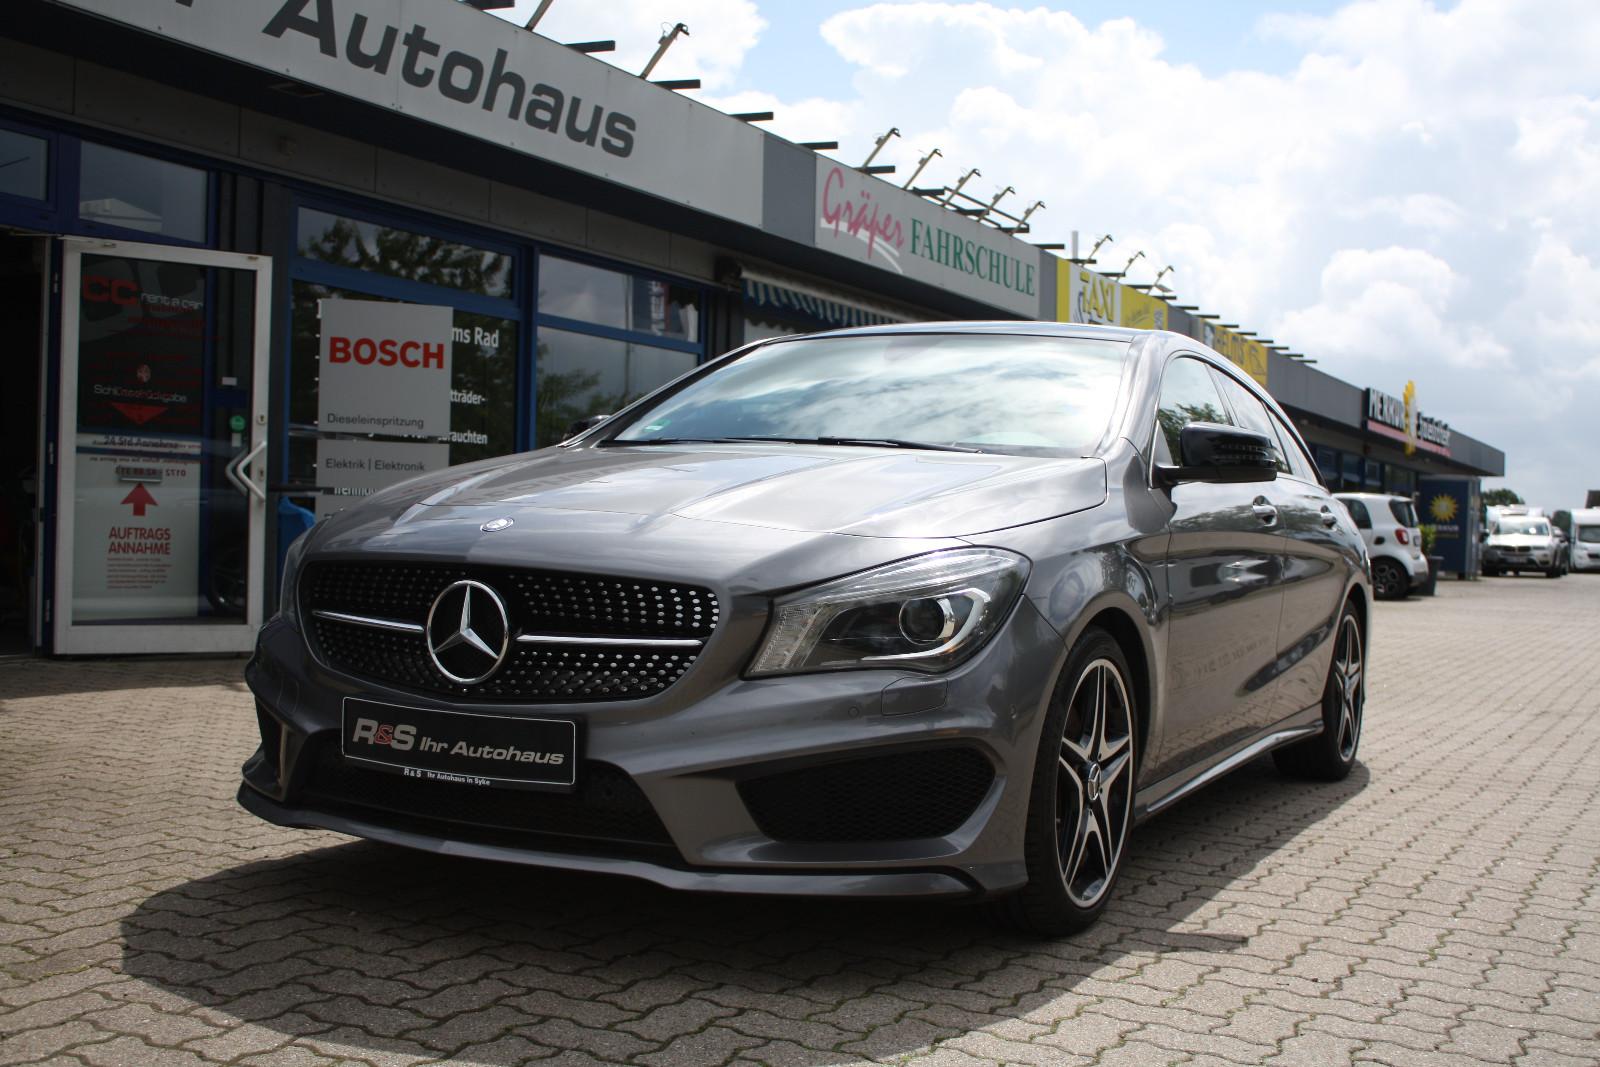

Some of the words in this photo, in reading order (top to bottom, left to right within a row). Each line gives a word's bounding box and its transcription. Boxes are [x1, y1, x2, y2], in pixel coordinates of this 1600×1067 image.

[263, 0, 636, 157] Autohaus
[909, 217, 1036, 297] FAHRSCHULE
[474, 326, 500, 348] Rad
[328, 336, 445, 369] BOSCH
[327, 412, 425, 429] Dieseleinspritzung
[325, 457, 365, 471] Elektrik
[374, 459, 425, 472] Elektronik
[108, 526, 171, 540] AUFTRAGS
[108, 541, 171, 555] ANNAHME
[352, 717, 417, 751] R&S
[419, 736, 448, 753] Ihr
[450, 741, 565, 765] Autohaus
[437, 773, 466, 783] Autohaus
